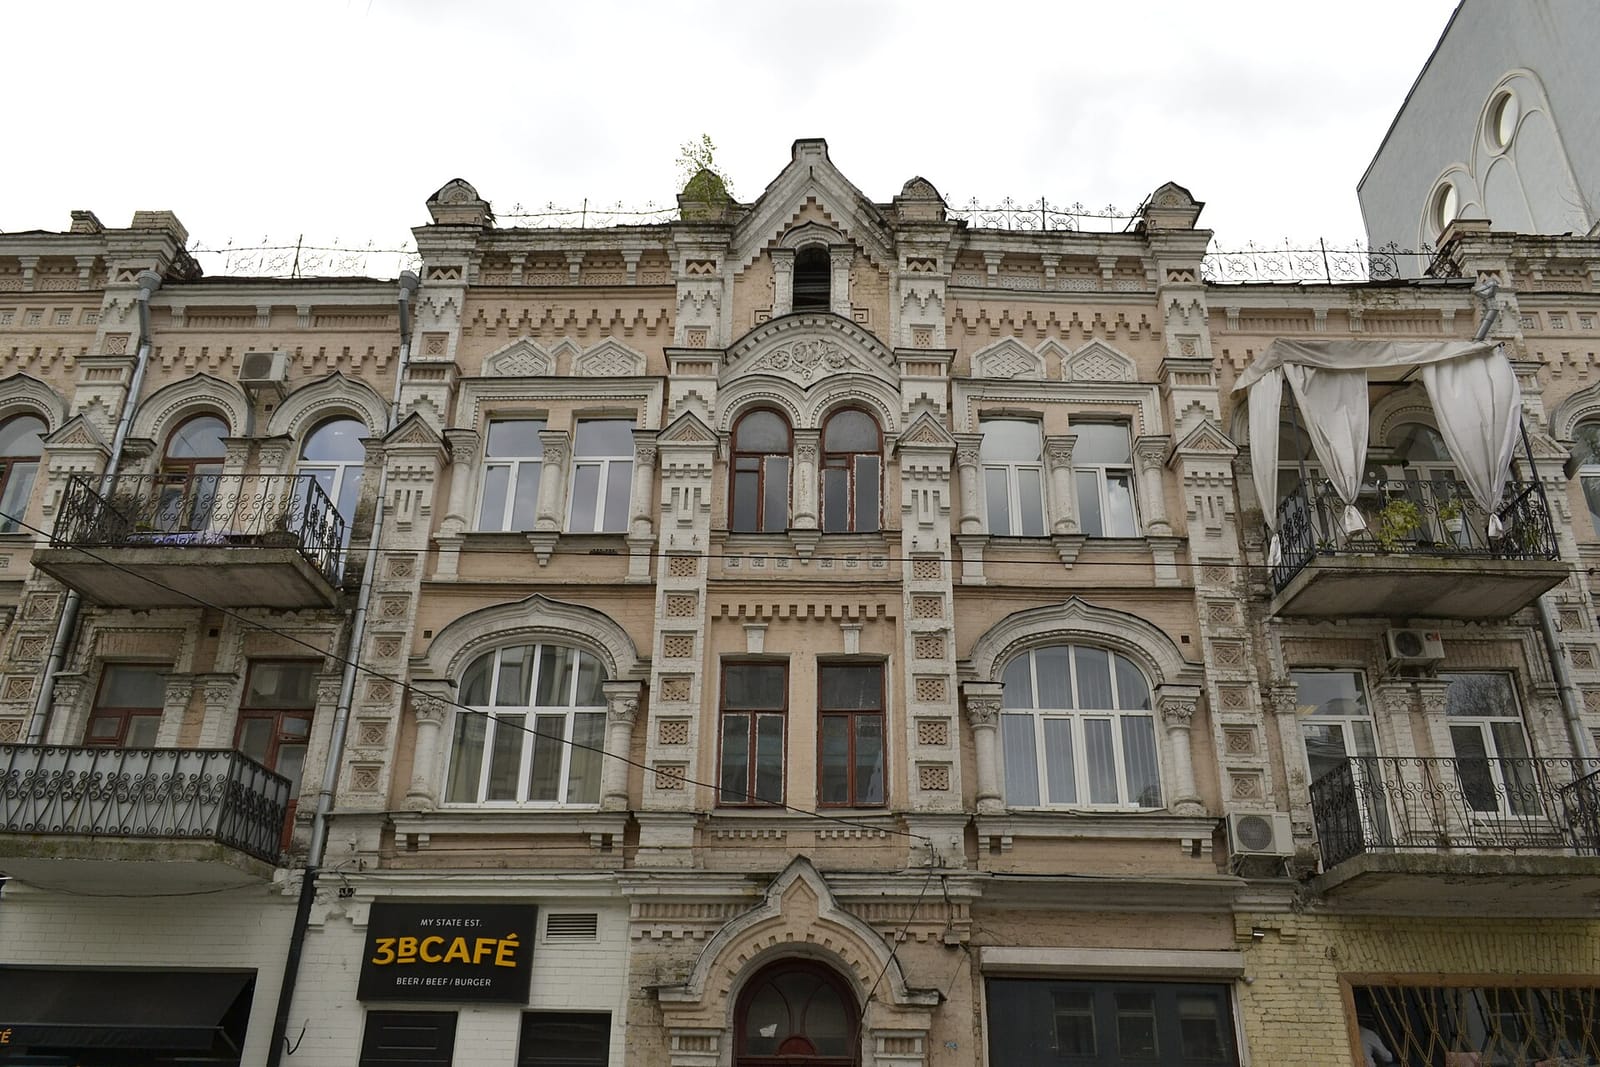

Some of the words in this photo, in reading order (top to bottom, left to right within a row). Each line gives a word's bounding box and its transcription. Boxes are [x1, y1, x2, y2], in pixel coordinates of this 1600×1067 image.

[420, 918, 434, 927] MY
[436, 918, 462, 927] STATE
[464, 919, 482, 928] EST.
[371, 932, 520, 968] 3BCAFÉ
[396, 977, 420, 985] BEER
[426, 977, 448, 986] BEEF
[454, 978, 492, 987] BURGER
